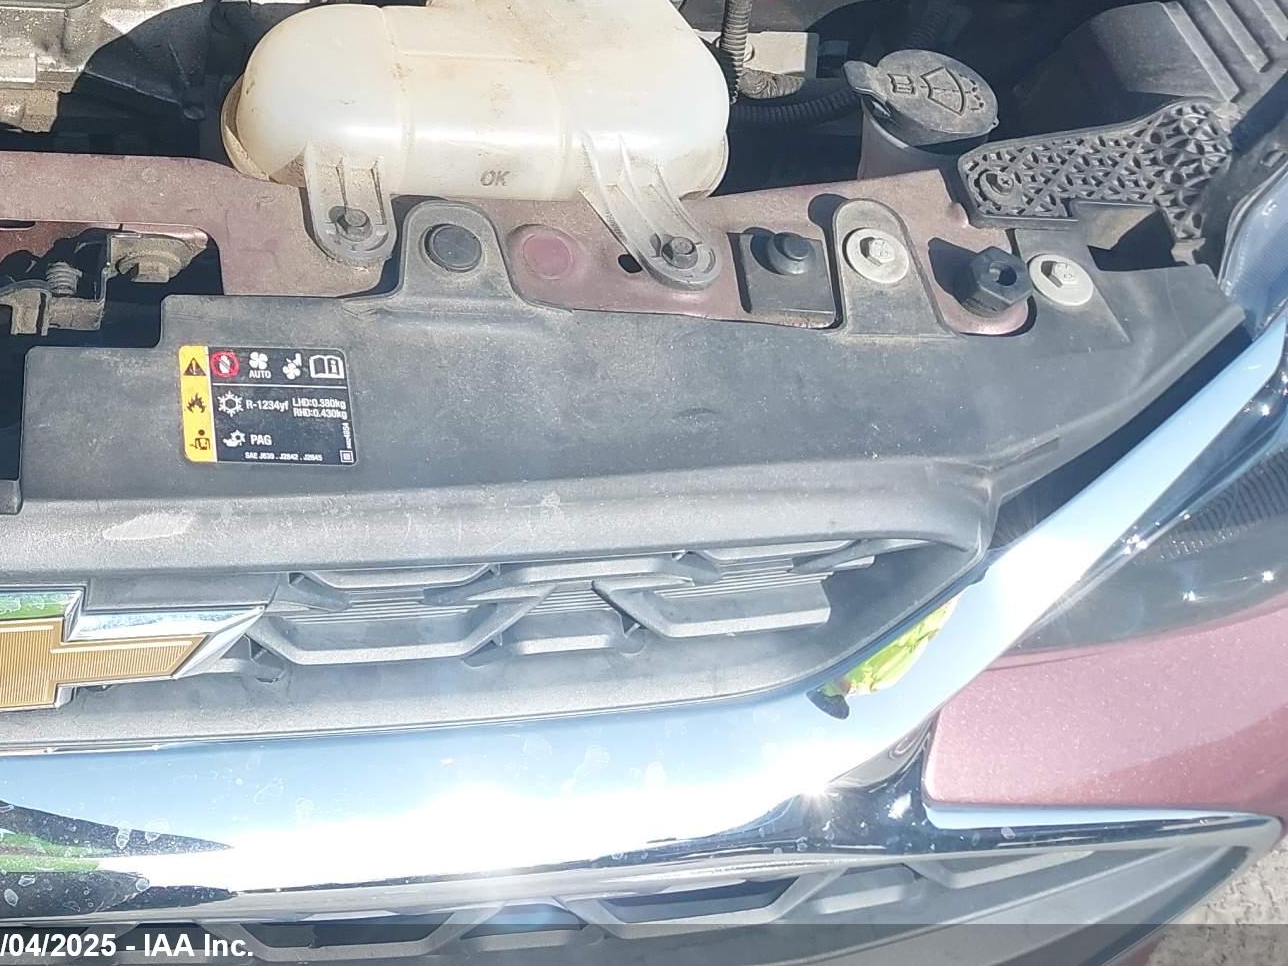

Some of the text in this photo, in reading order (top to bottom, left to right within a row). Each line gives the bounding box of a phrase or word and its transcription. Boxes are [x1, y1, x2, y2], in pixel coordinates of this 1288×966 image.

[479, 169, 511, 187] OK
[248, 369, 272, 379] AUTO
[245, 399, 289, 412] R-1234yf
[250, 434, 273, 446] PAG
